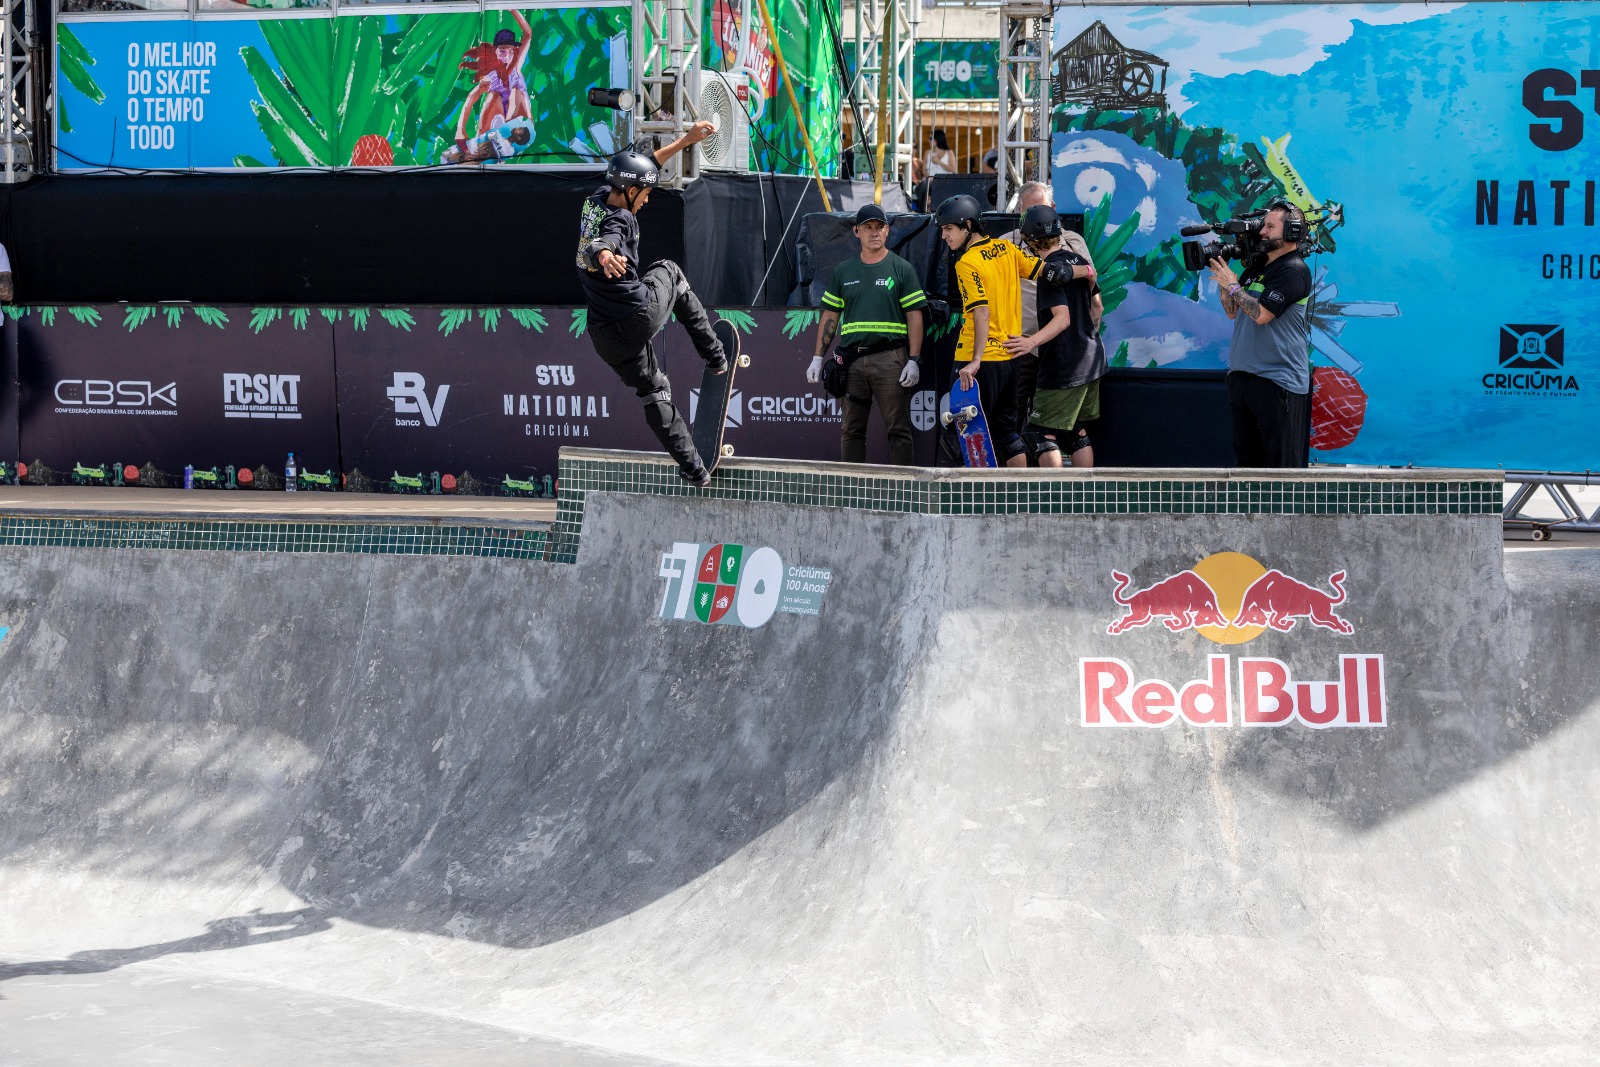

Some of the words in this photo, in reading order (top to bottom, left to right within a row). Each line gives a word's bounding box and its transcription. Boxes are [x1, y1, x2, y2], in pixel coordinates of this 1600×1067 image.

[128, 42, 139, 67] O
[144, 41, 217, 67] MELHOR
[128, 70, 153, 95] DO
[156, 69, 211, 95] SKATE
[128, 98, 139, 123] O
[143, 97, 204, 122] TEMPO
[127, 125, 174, 150] TODO
[1475, 180, 1596, 226] NATI
[535, 364, 576, 386] STU
[1482, 370, 1580, 391] CRICIÚMA
[54, 379, 177, 407] CBSK
[223, 373, 301, 405] FCSKT
[386, 371, 451, 427] BV
[54, 407, 97, 415] CONFEDERAÇÃO
[503, 394, 610, 418] NATIONAL
[747, 392, 843, 416] CRICIÚM
[395, 417, 421, 427] banco
[525, 422, 589, 437] CRICIÚMA
[788, 566, 831, 580] Criciúma
[786, 579, 801, 591] 100
[802, 581, 826, 593] Anos
[1080, 655, 1231, 727] Red
[1241, 655, 1386, 727] Bull
